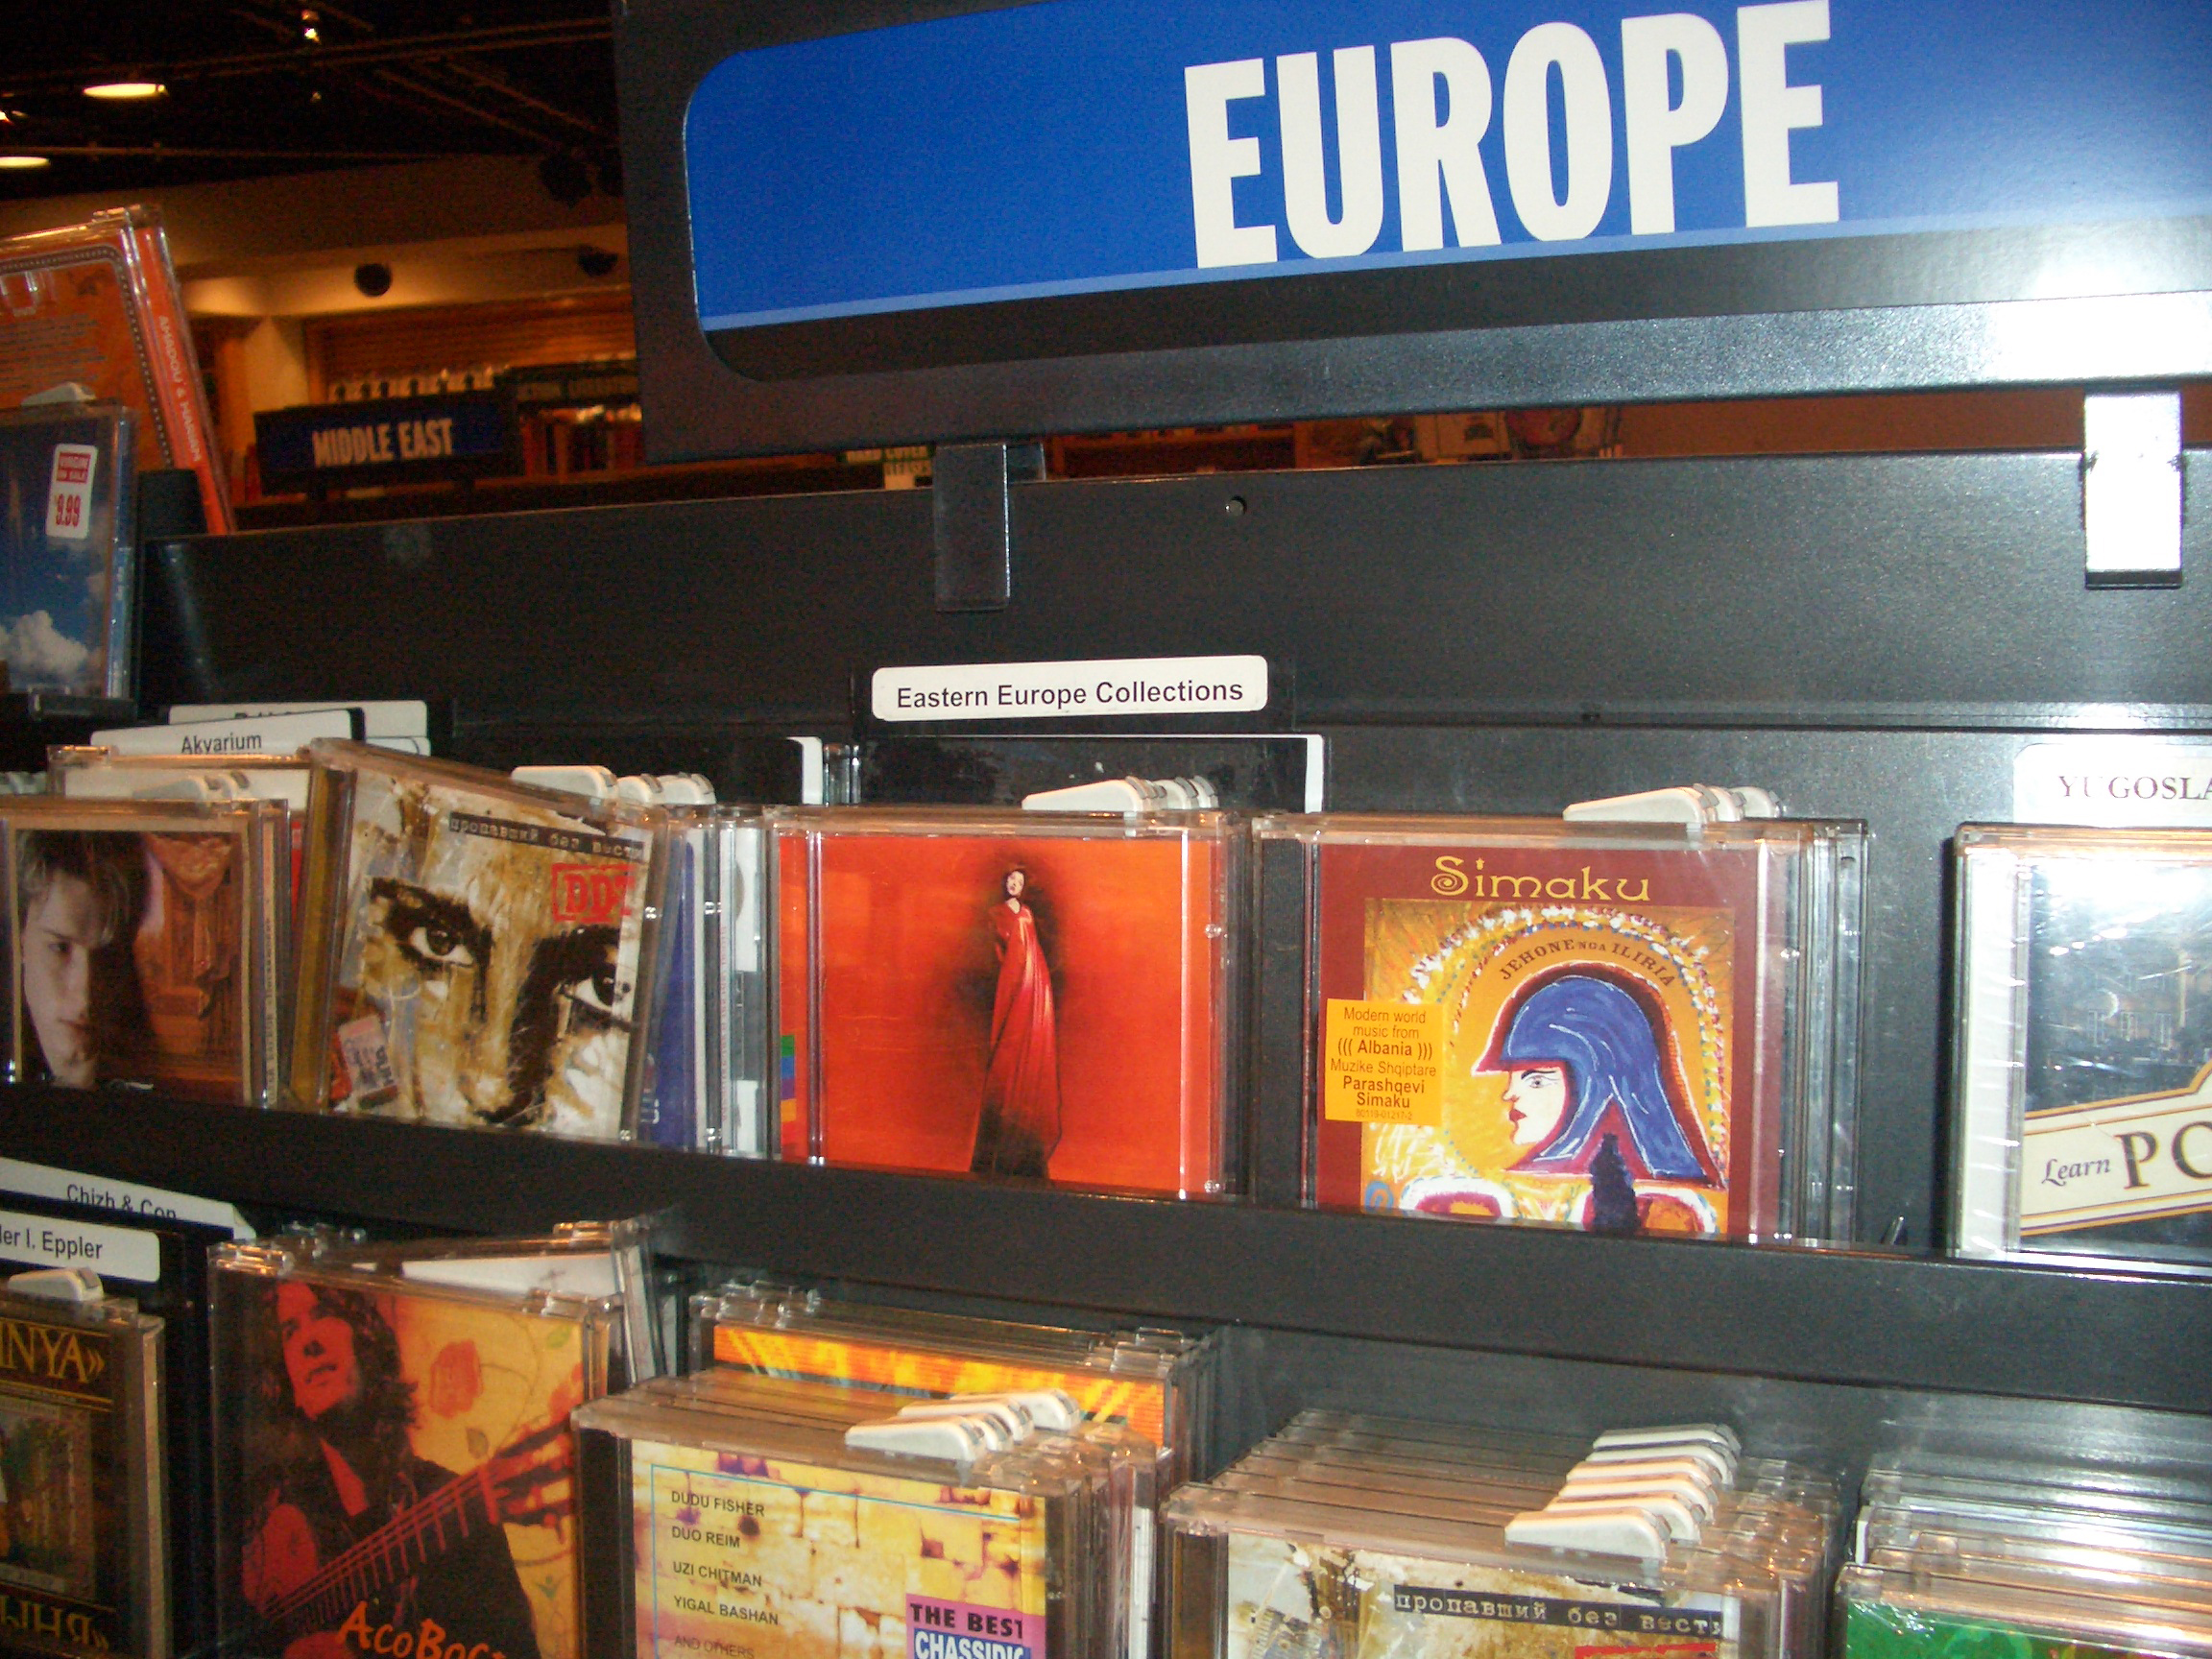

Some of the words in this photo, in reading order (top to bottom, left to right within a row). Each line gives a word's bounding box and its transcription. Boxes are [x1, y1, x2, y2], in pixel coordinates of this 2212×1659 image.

[1185, 0, 1839, 269] EUROPE
[312, 423, 394, 468] MIDDLE
[397, 418, 453, 460] EAST
[898, 686, 988, 708] Eastern
[998, 685, 1087, 709] Europe
[1095, 680, 1243, 703] Collections
[181, 732, 262, 754] Akvarium
[1430, 855, 1650, 902] Simaku
[1499, 939, 1575, 980] JEHONE
[1612, 943, 1675, 987] ILIRIA
[1344, 1006, 1389, 1022] Modern
[1393, 1010, 1426, 1023] world
[1353, 1024, 1388, 1038] music
[1392, 1025, 1419, 1039] from
[1358, 1039, 1412, 1056] Albania
[1330, 1058, 1373, 1073] Muzike
[1378, 1060, 1436, 1077] Shqiptare
[1343, 1075, 1425, 1095] Parashqevi
[1357, 1092, 1410, 1109] Simaku
[2042, 1158, 2110, 1187] Learn
[66, 1184, 115, 1211] Chizh
[121, 1194, 133, 1214] &
[42, 1230, 103, 1261] Eppler
[672, 1490, 709, 1508] DUDU
[714, 1497, 765, 1517] FISHER
[672, 1526, 702, 1542] DUO
[706, 1531, 740, 1548] REIM
[673, 1561, 694, 1575] UZI
[699, 1565, 762, 1588] CHITMAN
[673, 1595, 714, 1615] YIGAL
[719, 1603, 779, 1625] BASHAN
[910, 1602, 956, 1628] THE
[967, 1611, 1023, 1639] BEST
[1395, 1592, 1548, 1621] пропавший
[1567, 1606, 1619, 1626] без
[674, 1635, 700, 1650] AND
[704, 1640, 756, 1659] OTHERS
